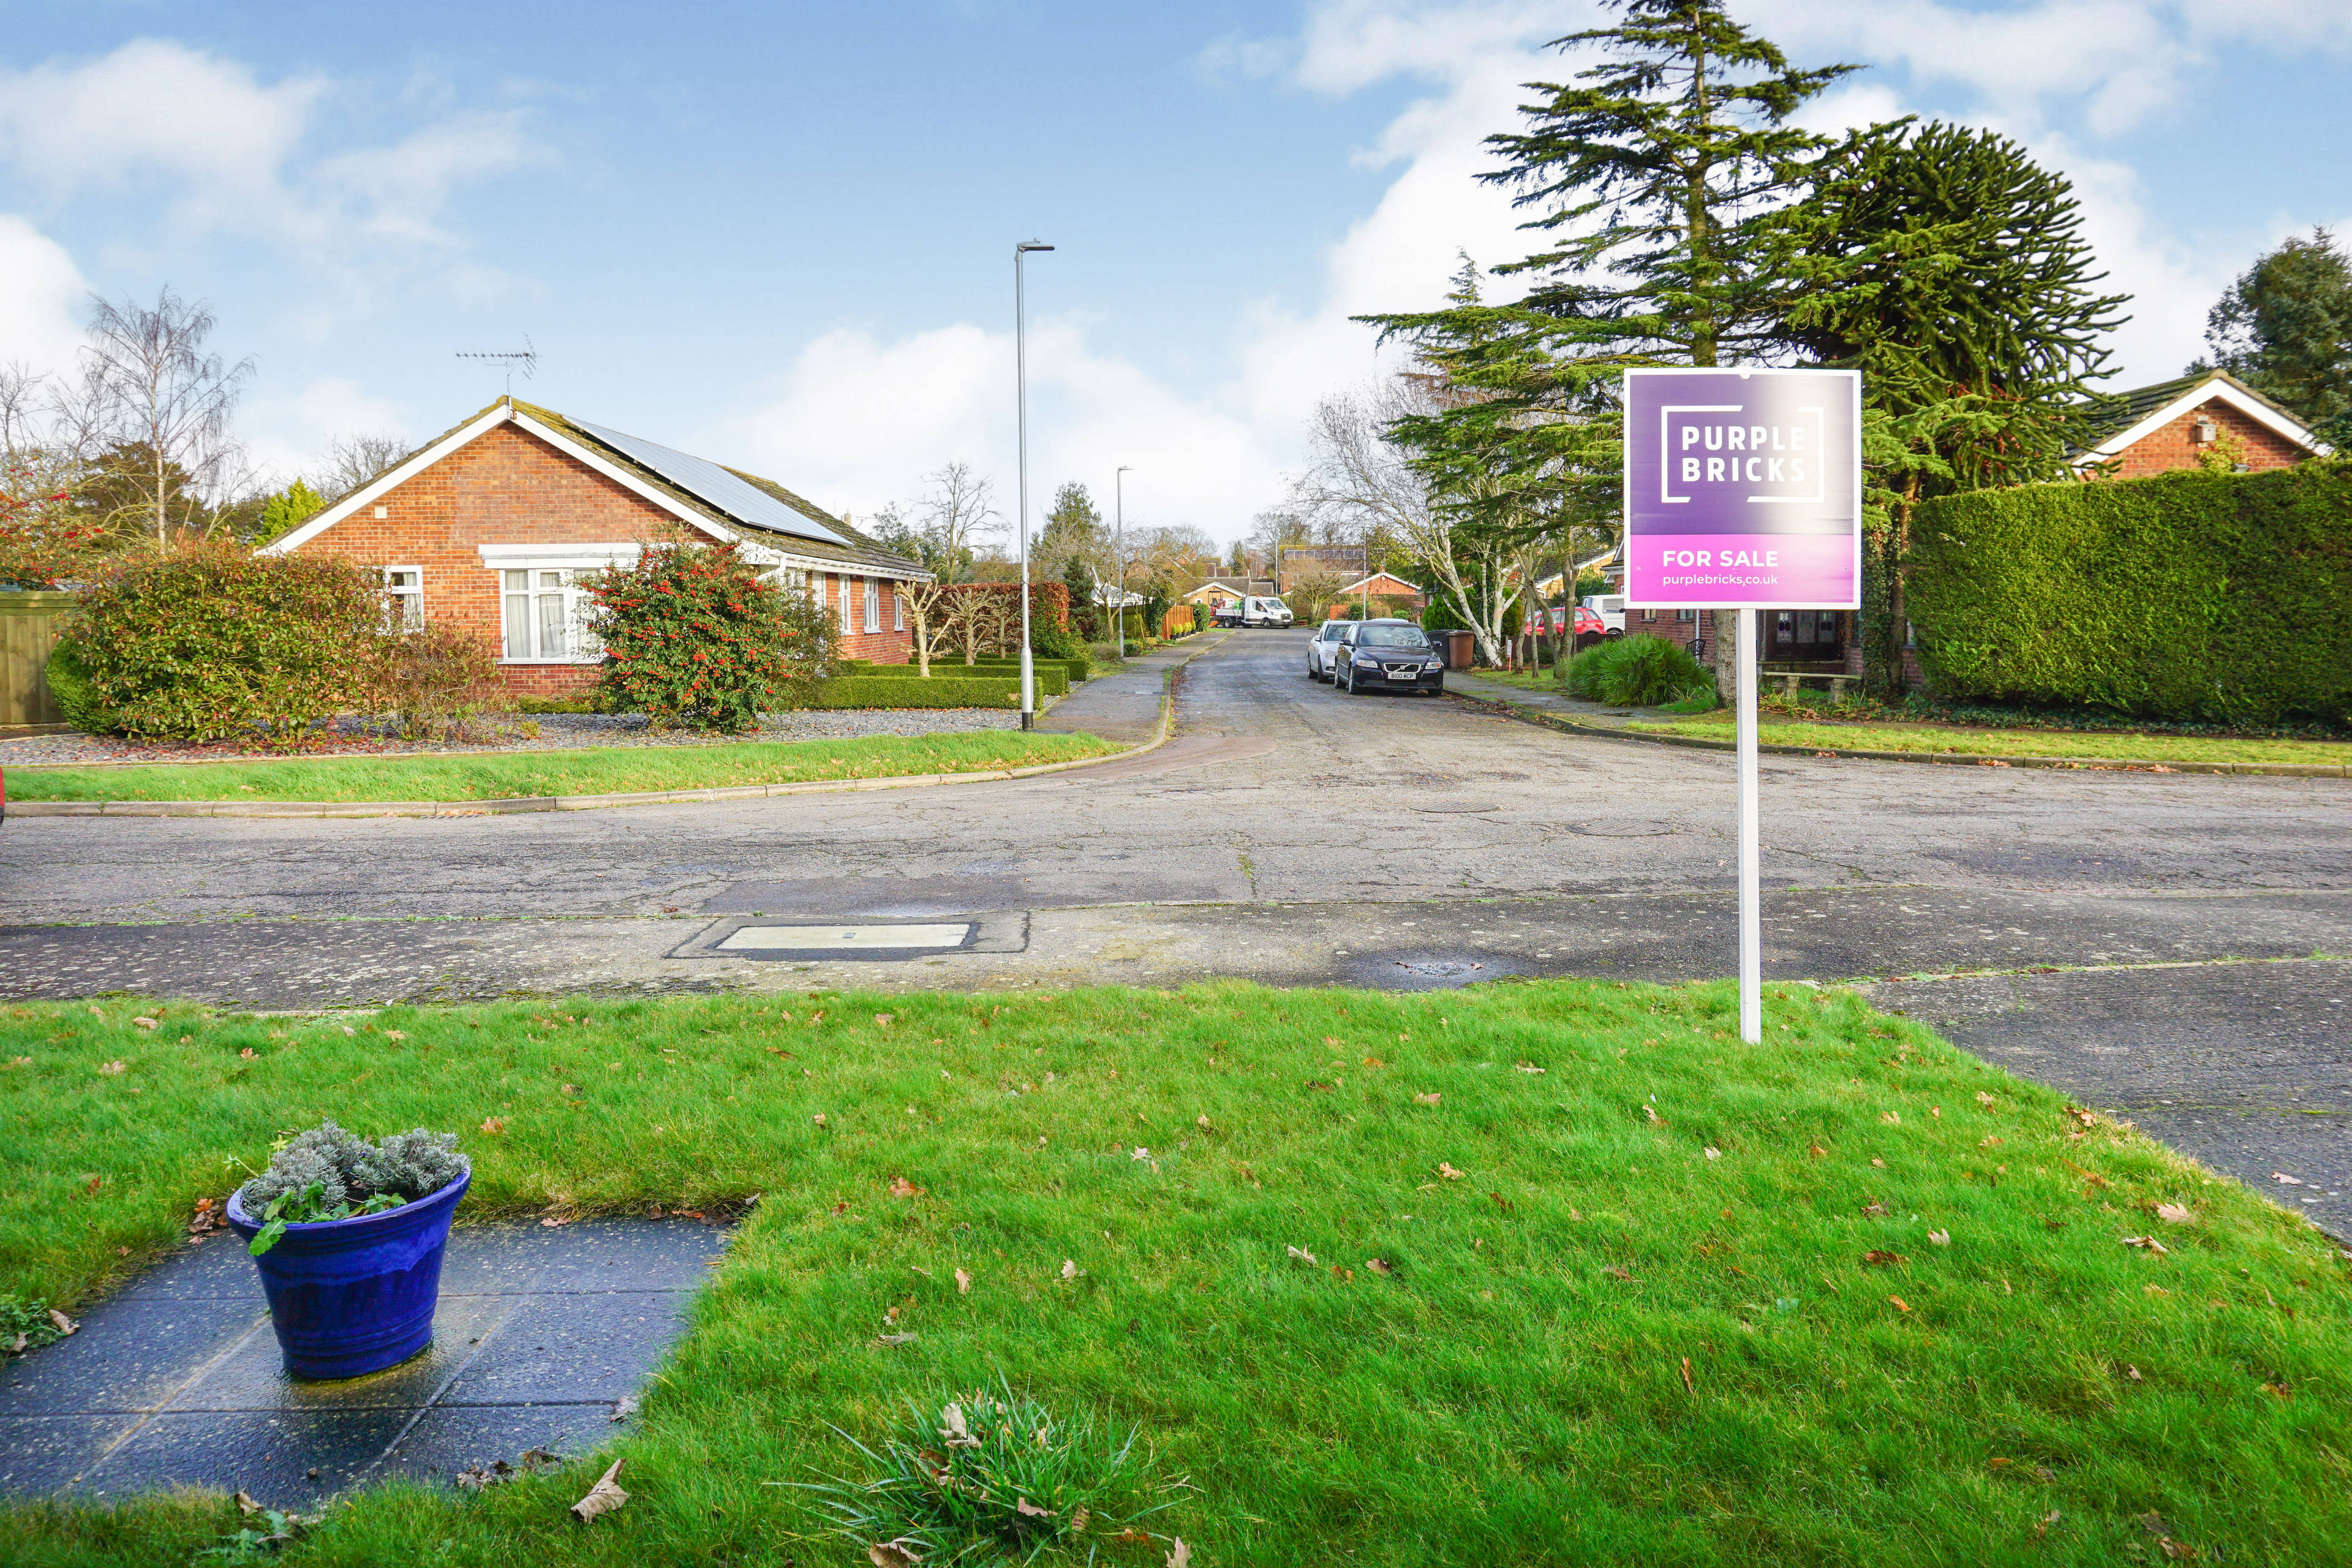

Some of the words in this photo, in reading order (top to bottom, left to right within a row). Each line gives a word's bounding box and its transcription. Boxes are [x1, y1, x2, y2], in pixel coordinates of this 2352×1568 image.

[1682, 426, 1804, 451] PURPLE
[1682, 457, 1805, 482] BRICKS
[1663, 551, 1711, 567] FOR
[1720, 550, 1779, 567] SALE
[1663, 574, 1779, 586] purplebricks.co.uk
